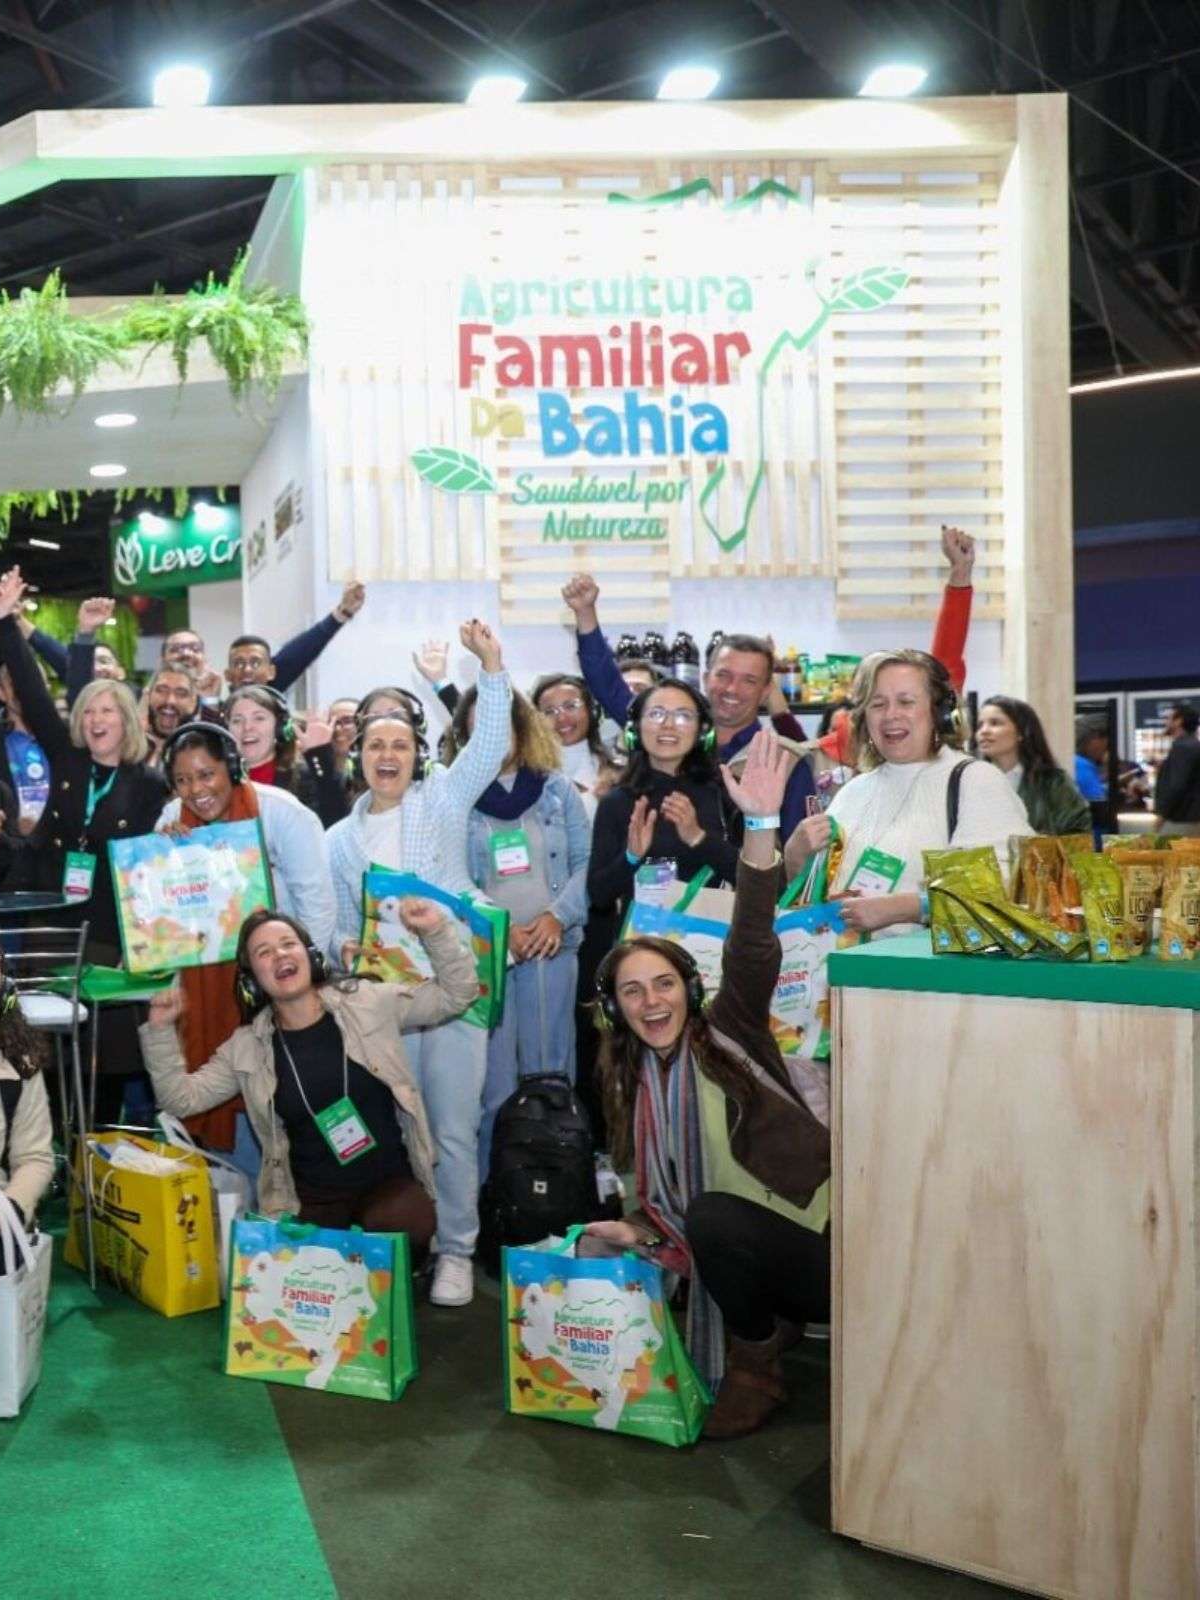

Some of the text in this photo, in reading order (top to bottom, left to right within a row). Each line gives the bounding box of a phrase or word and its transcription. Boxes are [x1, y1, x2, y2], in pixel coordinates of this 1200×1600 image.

[461, 272, 754, 324] Agricultura
[458, 321, 751, 390] Familiar
[538, 391, 730, 459] Bahia
[512, 468, 688, 516] Saudável por
[542, 509, 667, 542] Natureza
[148, 544, 206, 574] Leve
[281, 1285, 337, 1305] Familiar
[296, 1301, 331, 1318] Bahia
[554, 1321, 614, 1342] Familiar
[570, 1338, 611, 1356] Bahia
